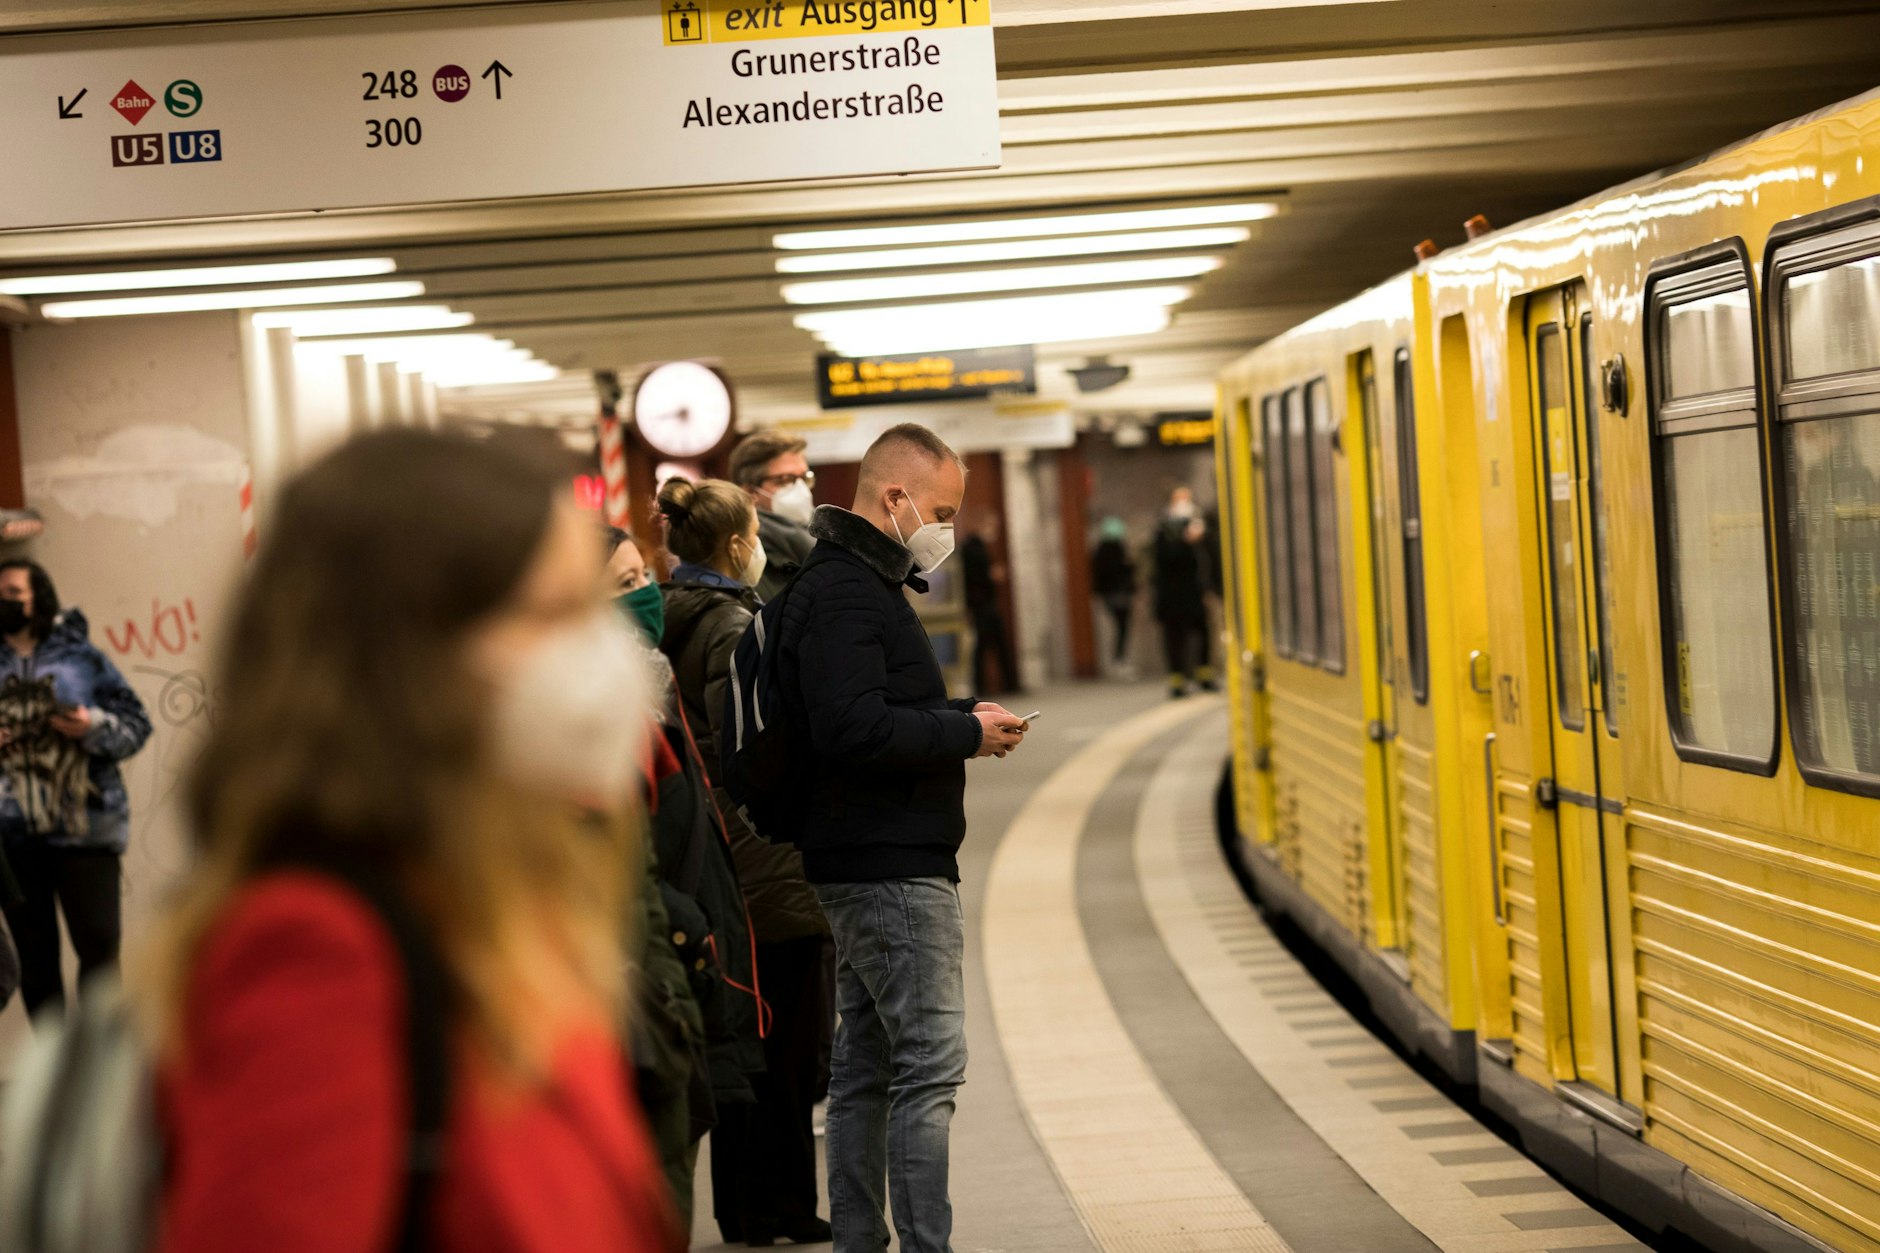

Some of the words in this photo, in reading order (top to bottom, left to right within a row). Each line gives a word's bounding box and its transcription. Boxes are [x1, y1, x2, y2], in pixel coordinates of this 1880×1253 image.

[725, 1, 785, 30] exit
[799, 0, 938, 30] Ausgang
[730, 36, 941, 78] Grunerstraße
[116, 95, 150, 110] Bahn
[170, 82, 198, 115] S
[361, 70, 419, 101] 248
[435, 75, 469, 92] BUS
[682, 83, 945, 129] Alexanderstraße
[117, 136, 159, 164] U5
[175, 132, 217, 160] U8
[364, 116, 423, 149] 300
